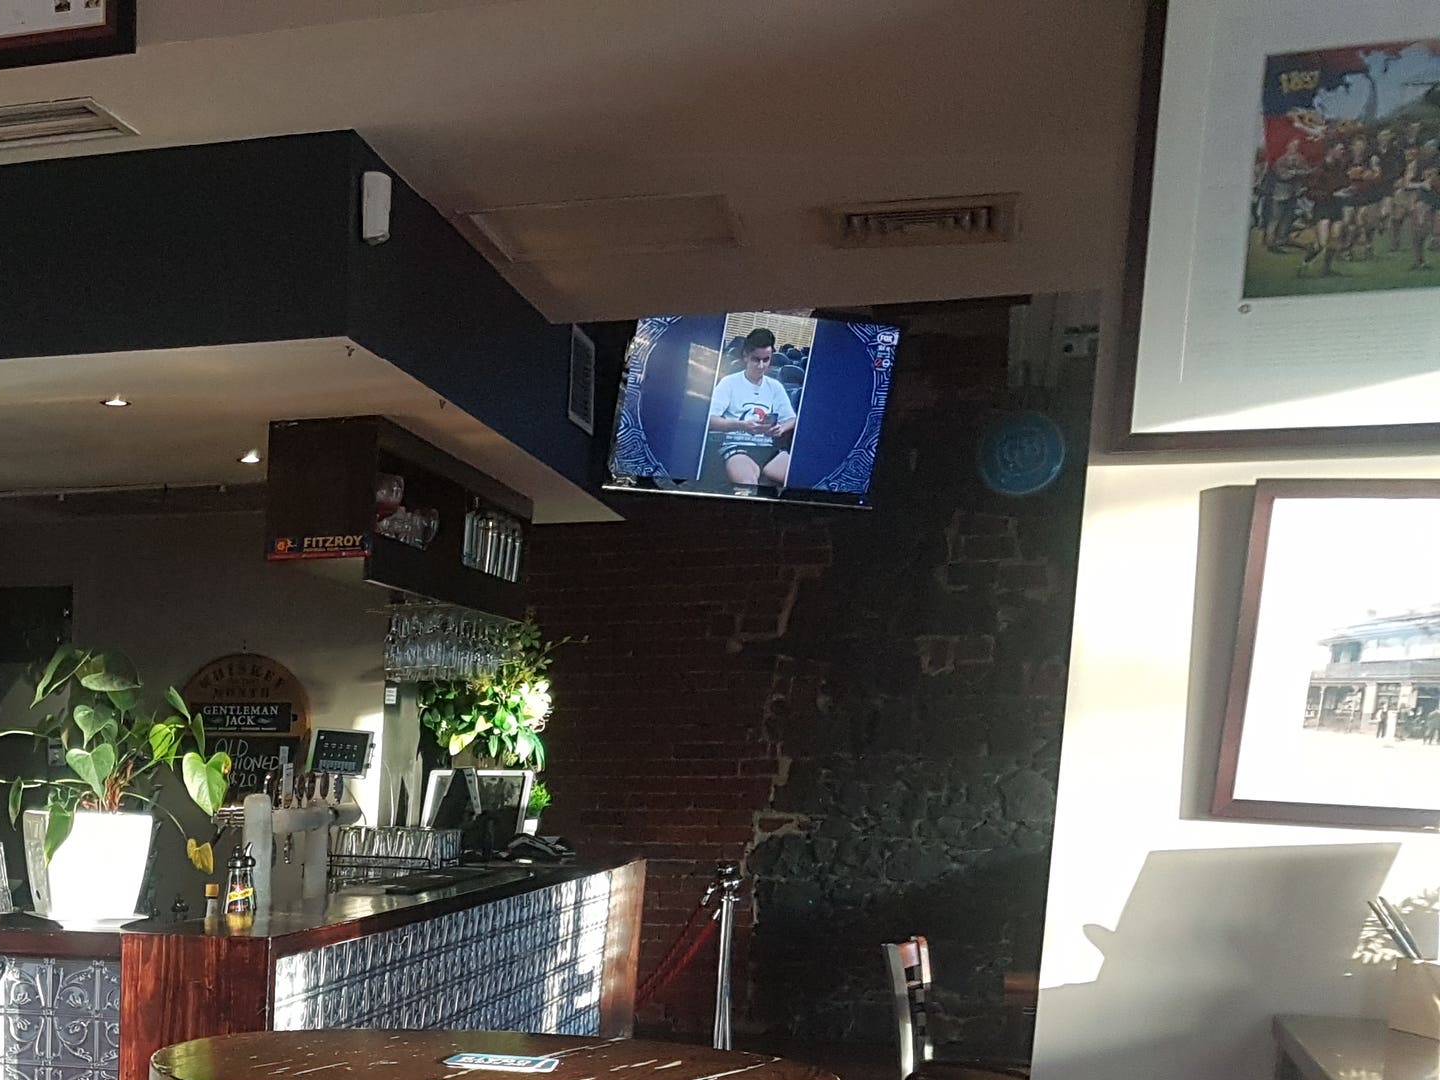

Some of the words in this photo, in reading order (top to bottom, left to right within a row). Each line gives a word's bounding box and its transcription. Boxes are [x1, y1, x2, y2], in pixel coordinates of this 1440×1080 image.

[880, 334, 893, 342] FOX
[303, 535, 363, 548] FITZROY
[203, 705, 279, 715] GENTLEMAN
[225, 715, 255, 727] JACK
[214, 738, 249, 758] OLD
